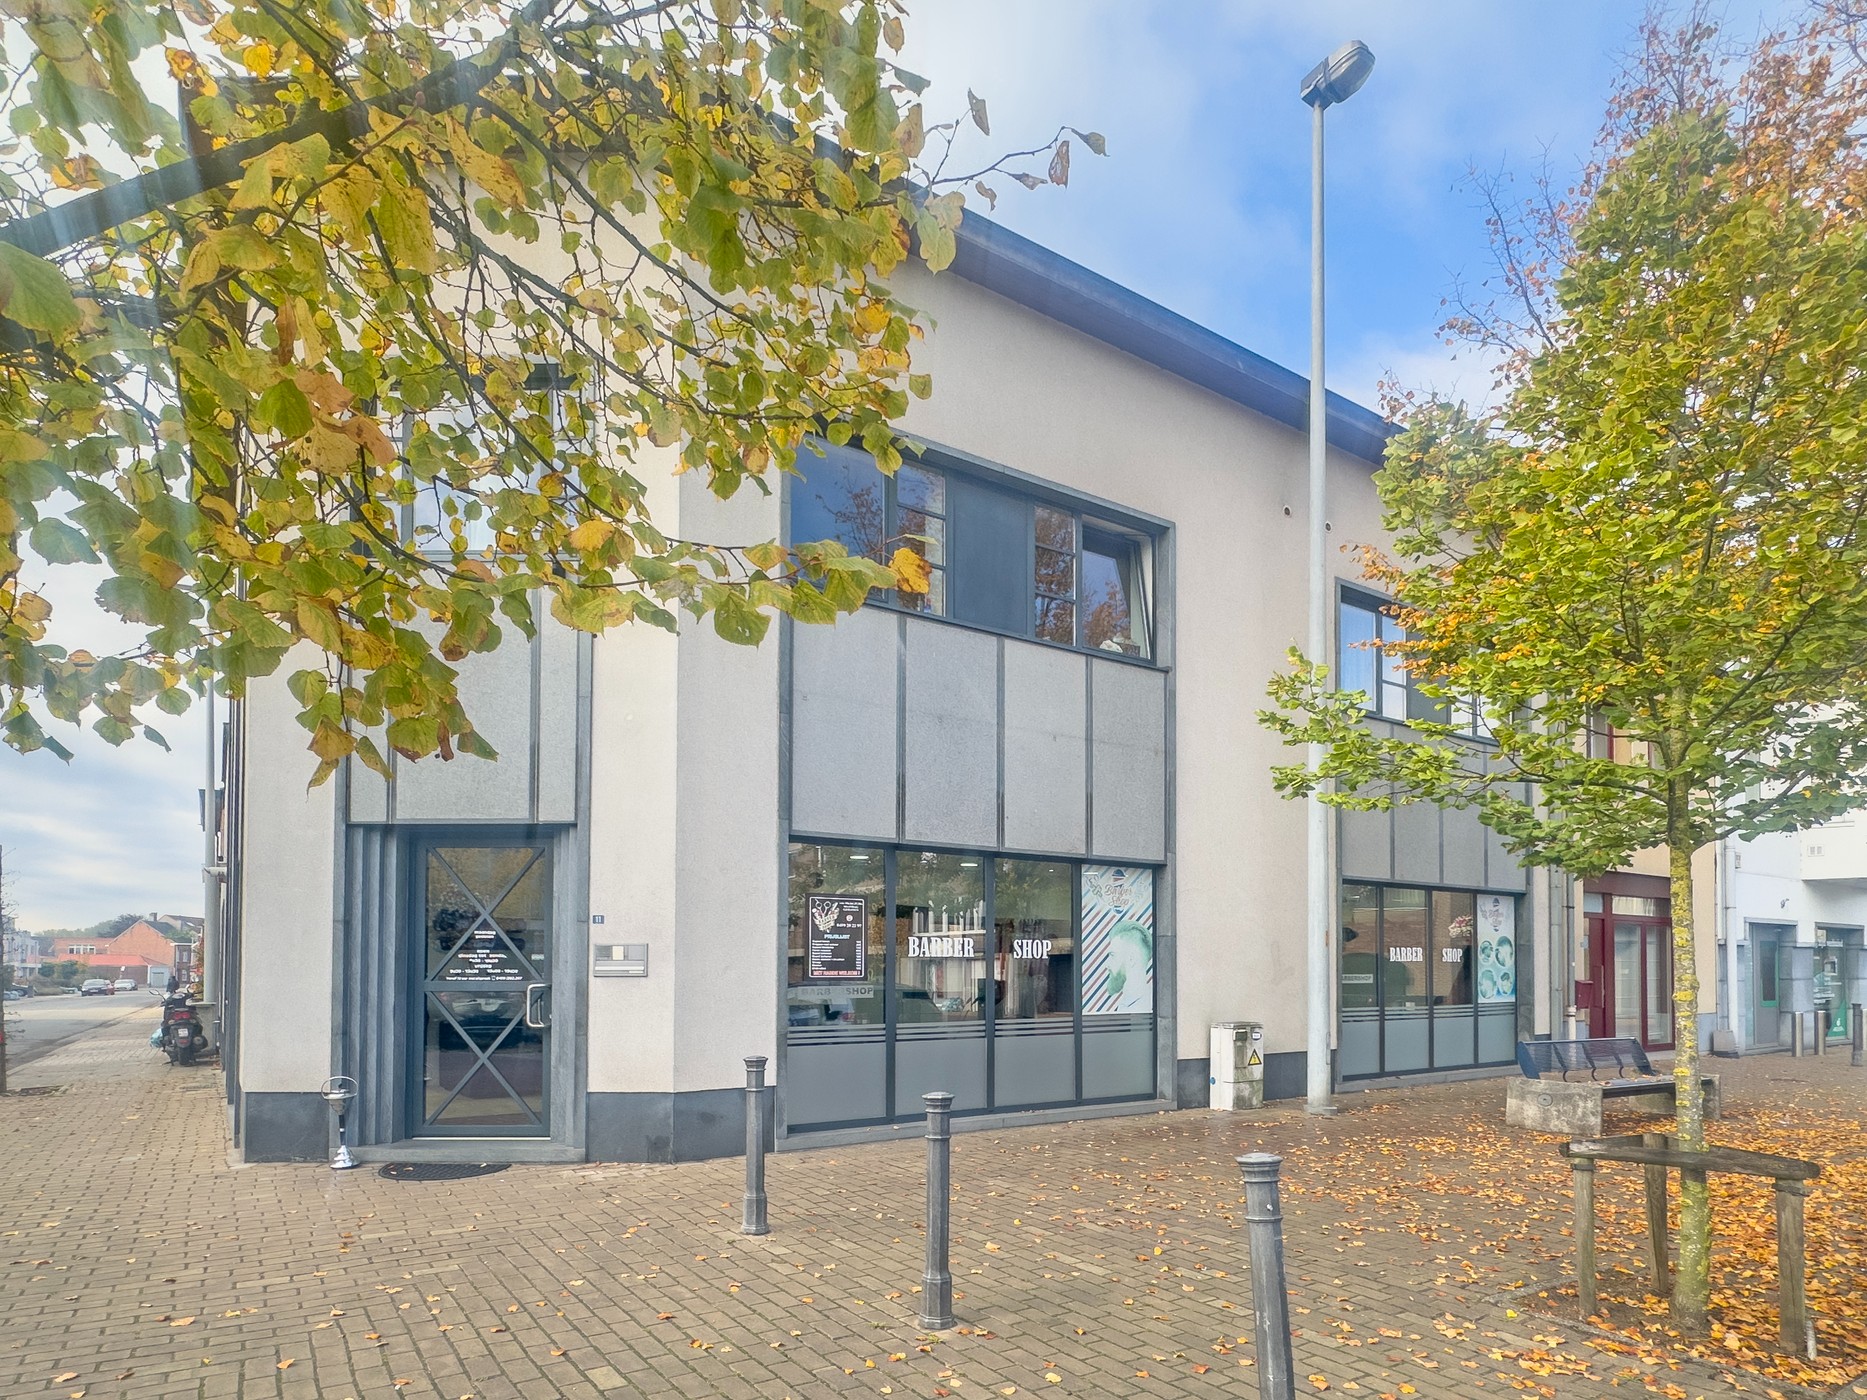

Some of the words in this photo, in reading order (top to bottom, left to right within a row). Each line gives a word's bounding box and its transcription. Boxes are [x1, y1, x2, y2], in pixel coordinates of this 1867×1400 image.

[908, 936, 975, 957] BARBER
[1013, 939, 1051, 959] SHOP
[1389, 947, 1423, 962] BARBER
[1442, 948, 1463, 962] SHOP
